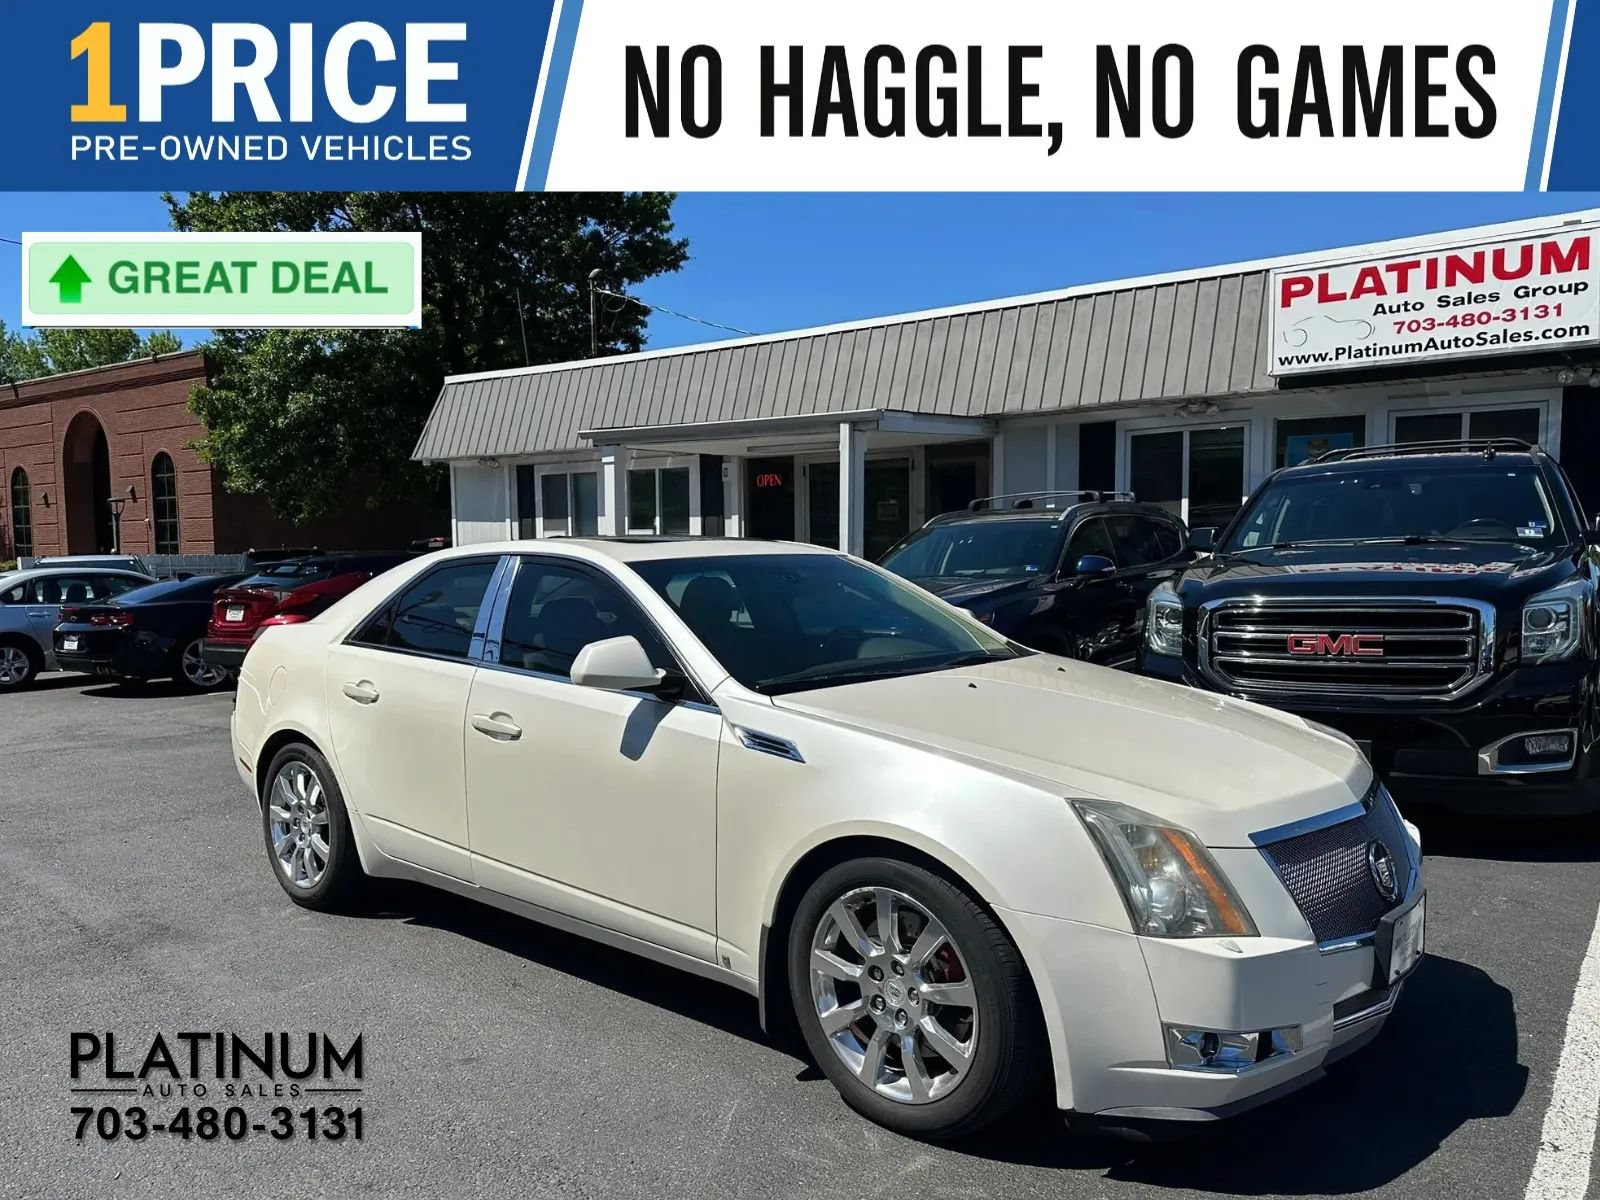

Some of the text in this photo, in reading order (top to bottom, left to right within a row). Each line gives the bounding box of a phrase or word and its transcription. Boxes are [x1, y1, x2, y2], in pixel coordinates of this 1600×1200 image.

[1280, 236, 1590, 309] PLATINUM
[1372, 279, 1589, 316] Auto Sales Group
[1393, 303, 1563, 335] 703-480-3131
[1278, 322, 1590, 367] www.PlatinumAutoSales.com
[756, 473, 782, 488] OPEN
[1287, 633, 1384, 655] GMC
